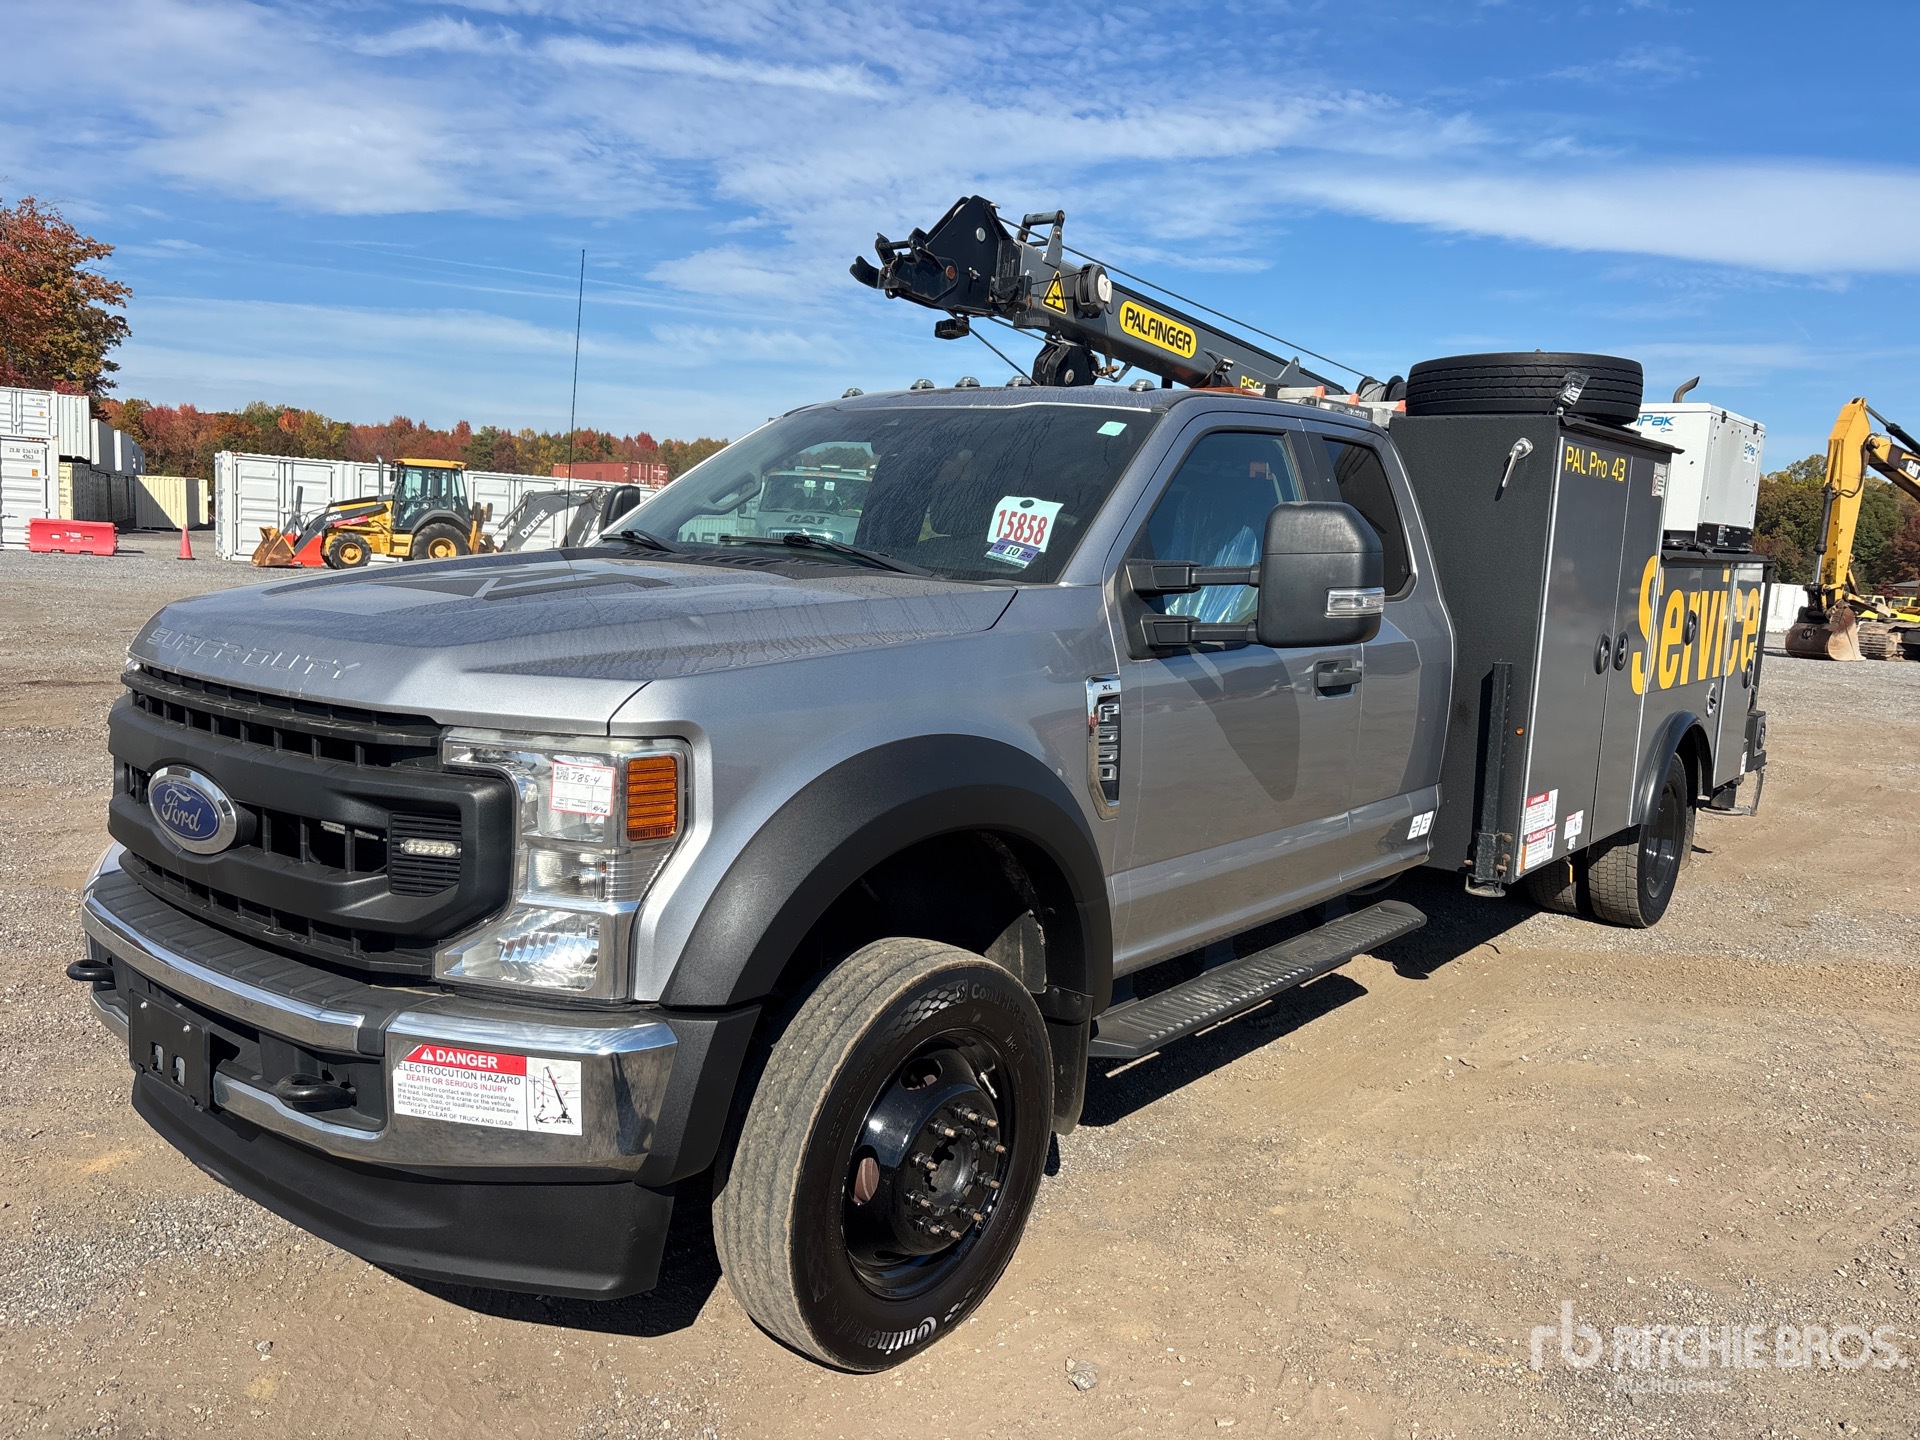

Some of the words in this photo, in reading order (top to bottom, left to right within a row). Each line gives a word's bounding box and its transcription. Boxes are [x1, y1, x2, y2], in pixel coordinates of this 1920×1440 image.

[1124, 306, 1192, 353] PALFINGER
[1565, 445, 1586, 475] PAL
[1588, 451, 1608, 479] Pro
[1611, 457, 1626, 482] 43
[520, 508, 548, 539] DEERE
[785, 515, 830, 525] CAT
[996, 509, 1048, 545] 15858
[1006, 546, 1020, 556] 10
[1631, 555, 1760, 695] Service
[146, 627, 244, 664] SUPER
[242, 647, 363, 680] DUTY
[161, 788, 202, 831] Ford
[435, 1049, 499, 1069] DANGER
[398, 1062, 477, 1080] ELECTROCUTION
[480, 1072, 521, 1086] HAZARD
[406, 1073, 431, 1083] DEATH
[432, 1077, 443, 1085] OR
[445, 1078, 478, 1090] SERIOUS
[480, 1084, 508, 1093] INJURY
[407, 1088, 420, 1096] load,
[421, 1090, 445, 1099] loadline,
[438, 1087, 460, 1095] contact
[481, 1092, 508, 1102] proximity
[398, 1100, 427, 1109] electrically
[428, 1103, 452, 1112] charged.
[412, 1095, 429, 1103] boom,
[452, 1101, 475, 1109] loadline
[475, 1104, 495, 1112] should
[496, 1106, 519, 1114] become
[427, 1110, 448, 1118] CLEAR
[459, 1114, 480, 1123] TRUCK
[480, 1117, 494, 1125] AND
[495, 1119, 513, 1127] LOAD
